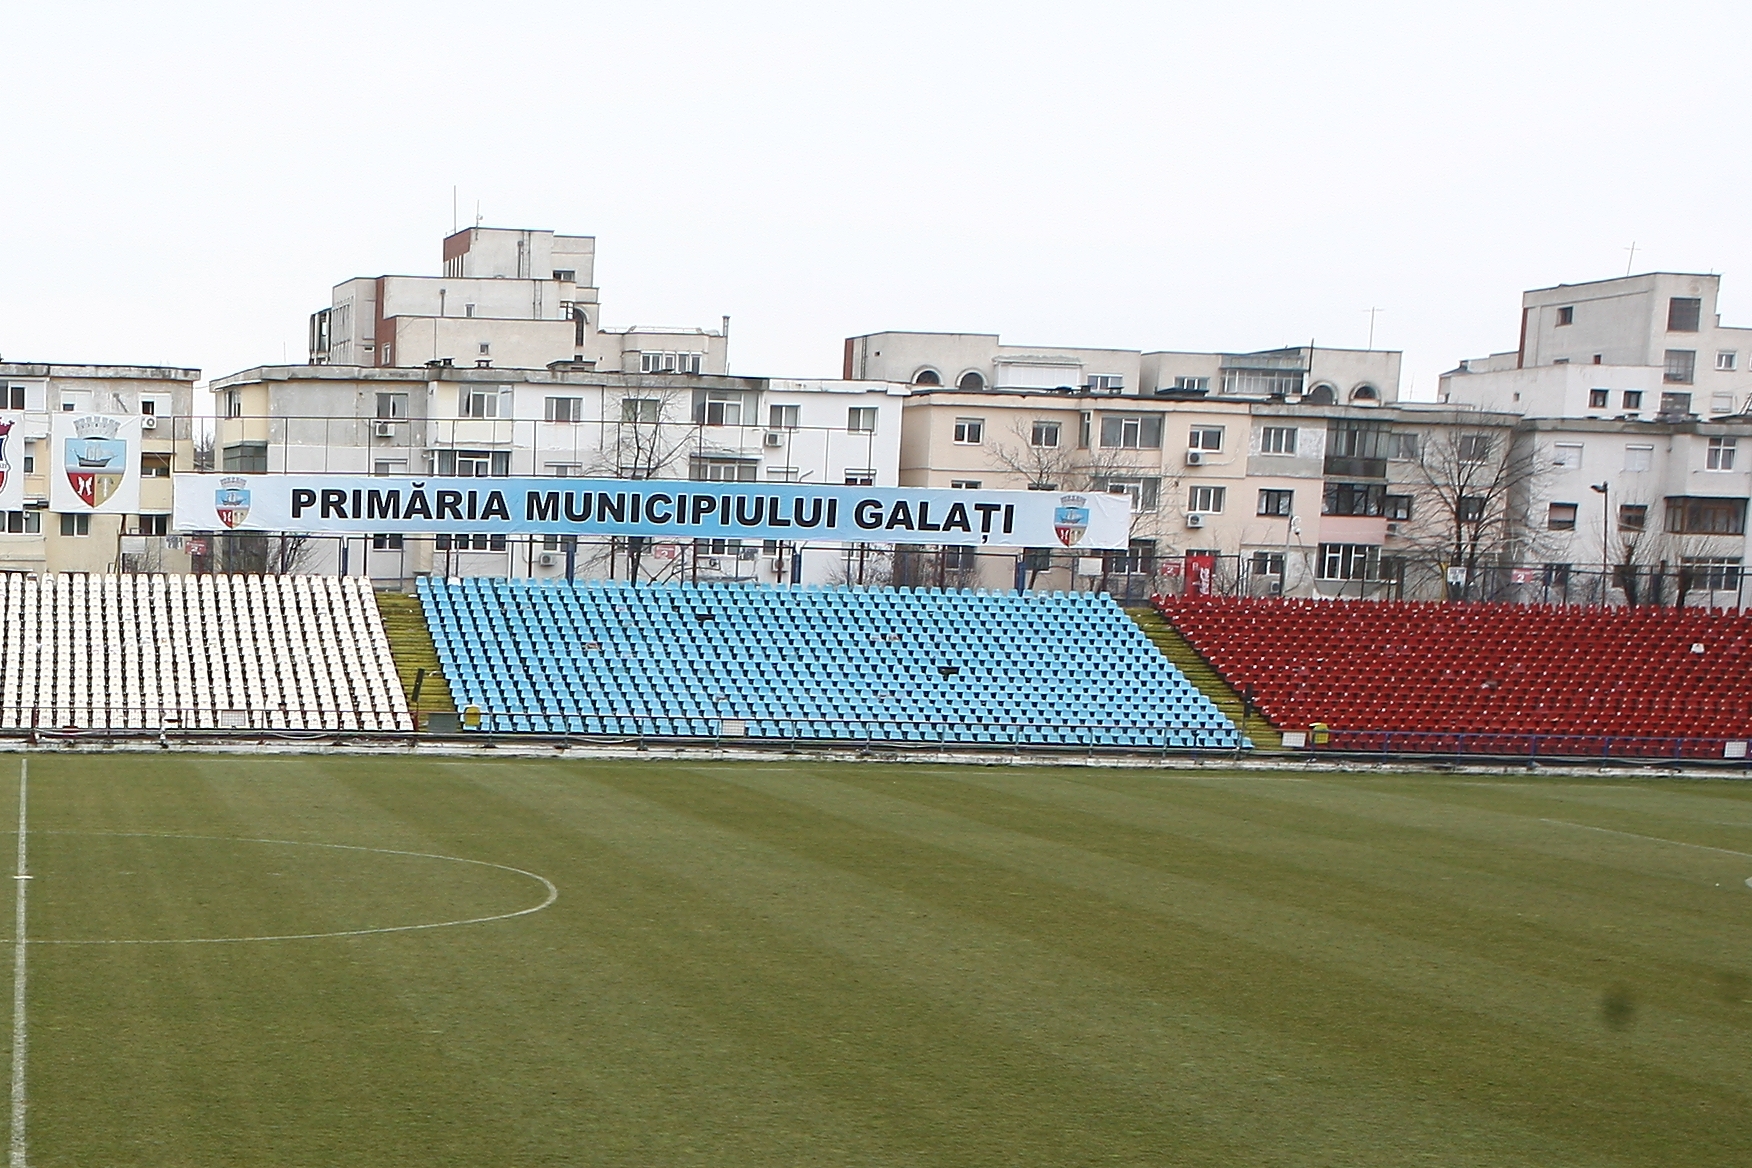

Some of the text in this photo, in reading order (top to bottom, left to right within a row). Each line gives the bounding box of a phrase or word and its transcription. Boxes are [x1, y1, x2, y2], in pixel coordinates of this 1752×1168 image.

[291, 481, 1015, 544] PRIMĂRIA MUNICIPIULUI GALAȚI
